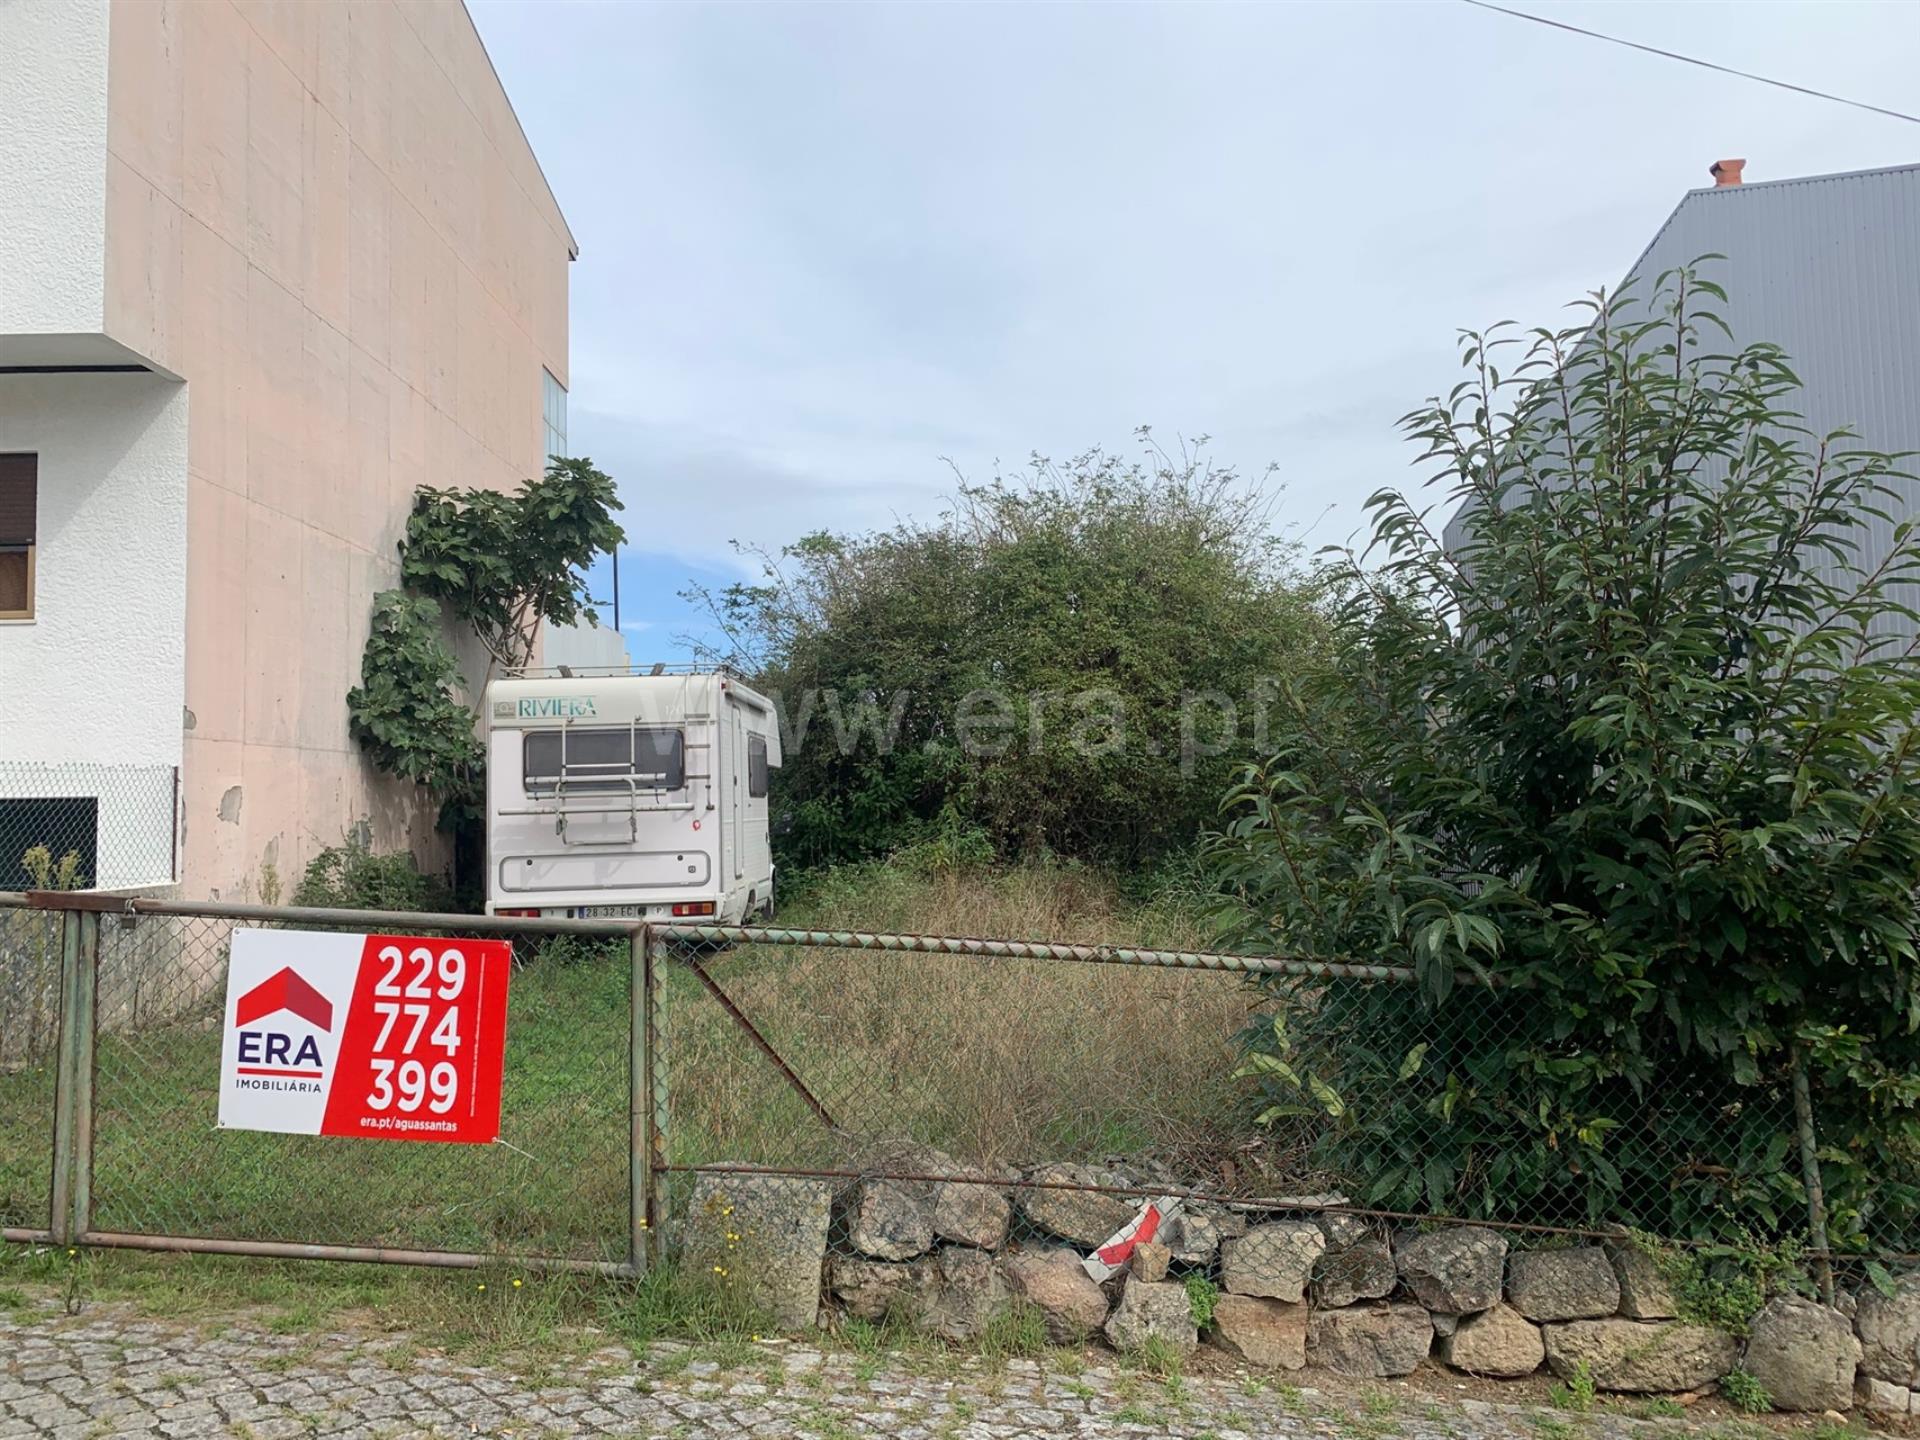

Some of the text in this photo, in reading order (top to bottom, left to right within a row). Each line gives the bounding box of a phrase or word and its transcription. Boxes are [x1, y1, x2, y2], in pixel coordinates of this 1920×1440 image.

[518, 697, 597, 717] RIVIERA
[374, 945, 466, 1000] 229
[371, 1002, 461, 1057] 774
[237, 1031, 323, 1067] ERA
[236, 1078, 322, 1094] IMOBILIÁRIA
[366, 1058, 459, 1114] 399
[360, 1116, 458, 1132] era.pt/aguassantas
